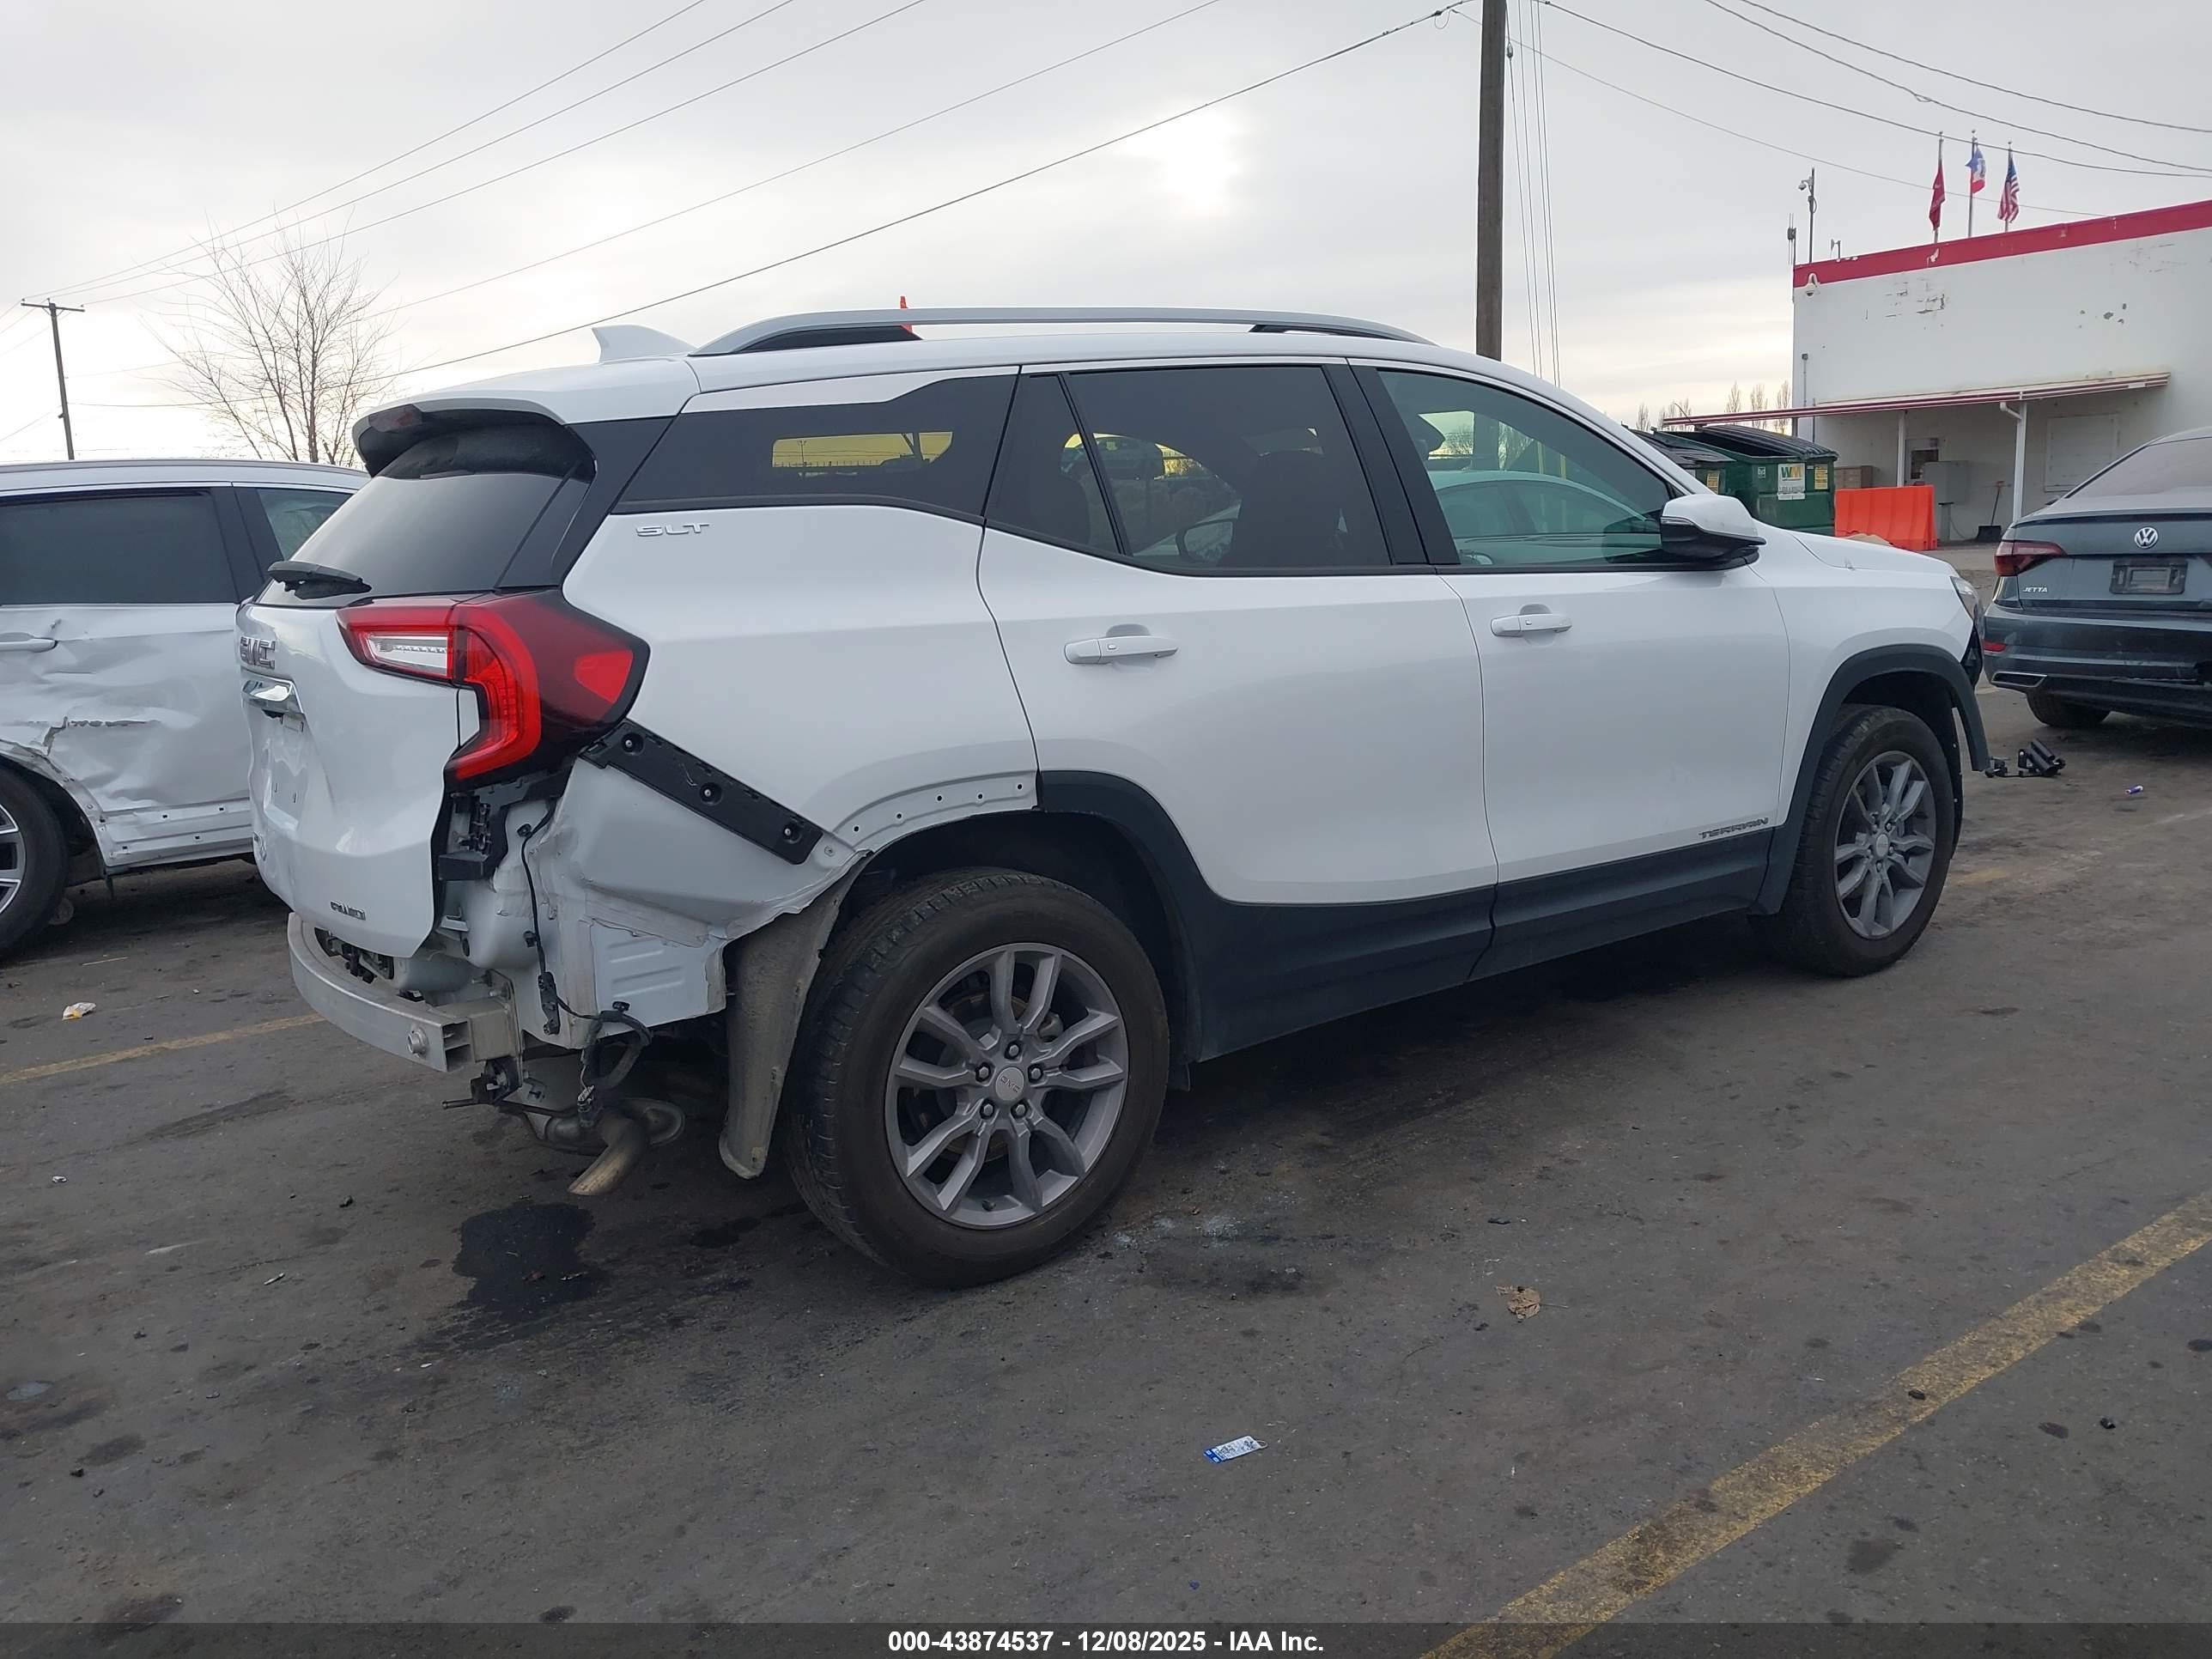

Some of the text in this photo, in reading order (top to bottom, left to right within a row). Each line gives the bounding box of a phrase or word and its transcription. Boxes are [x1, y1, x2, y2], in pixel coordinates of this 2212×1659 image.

[1781, 466, 1802, 478] WM
[636, 523, 709, 537] SLT
[240, 635, 276, 670] GMC
[1698, 817, 1769, 839] TERRAIN
[1000, 1075, 1021, 1093] GMC
